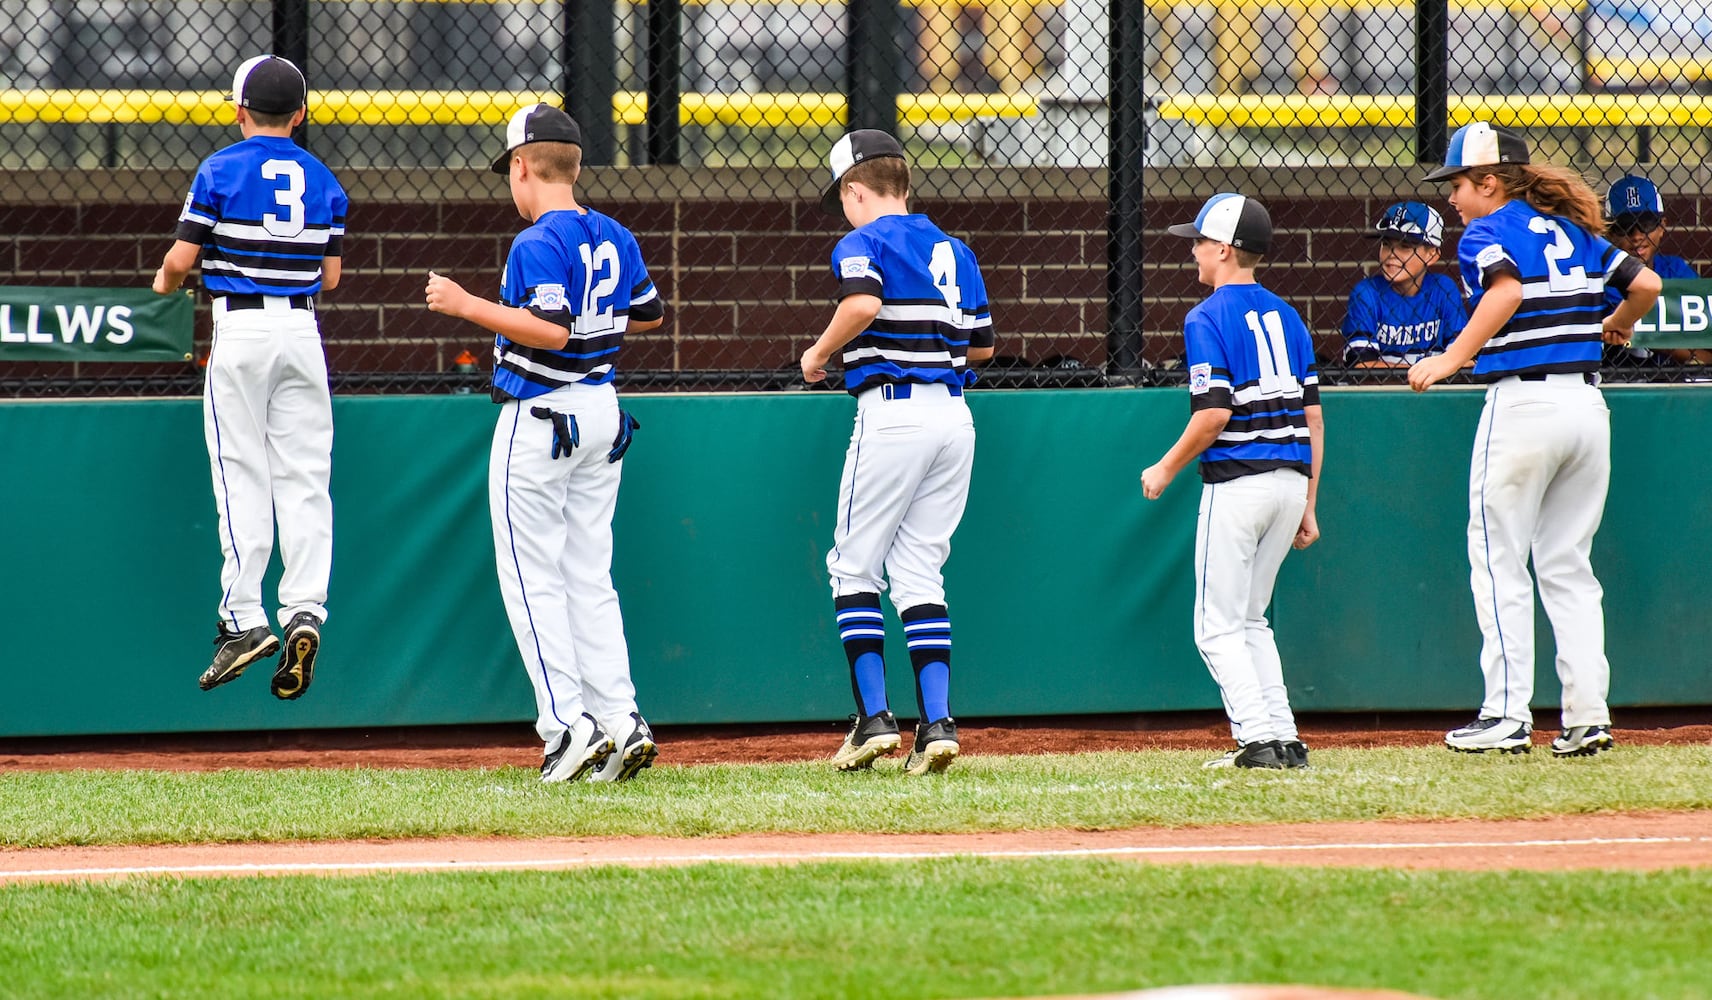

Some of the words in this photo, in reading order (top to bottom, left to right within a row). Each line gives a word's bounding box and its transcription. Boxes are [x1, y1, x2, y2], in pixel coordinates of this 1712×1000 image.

[260, 158, 306, 238] 3
[1626, 186, 1641, 208] H
[573, 239, 621, 335] 12
[927, 240, 963, 326] 4
[1527, 215, 1588, 293] 2
[0, 304, 134, 345] LLWS
[1244, 309, 1299, 395] 11
[1377, 319, 1441, 346] AMILTO
[1633, 295, 1712, 332] LLB
